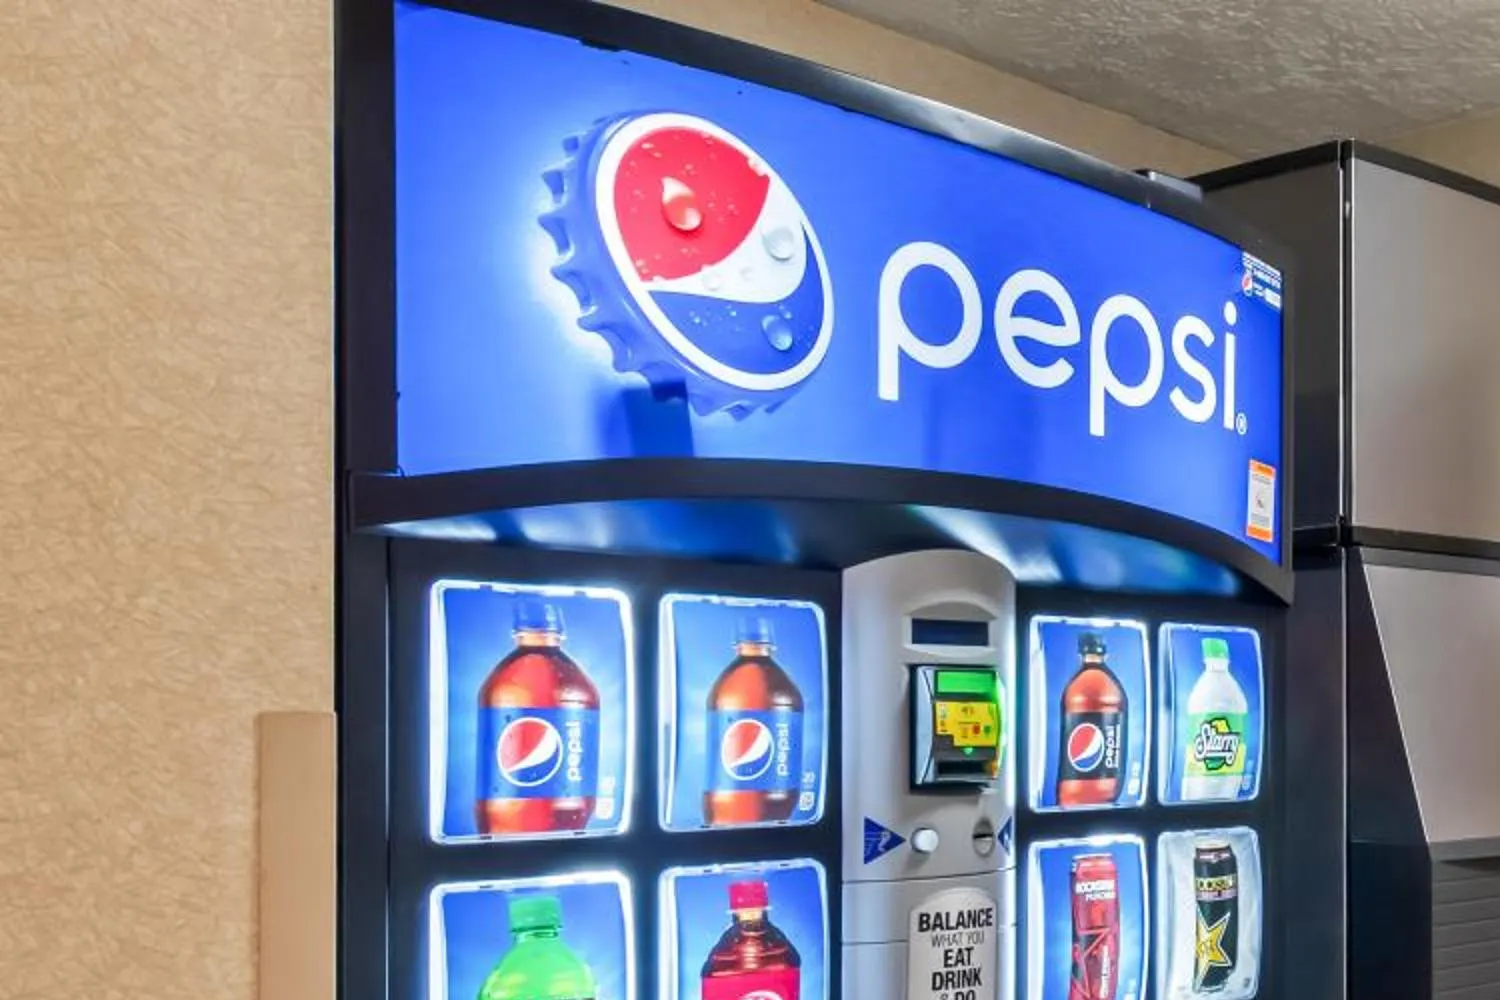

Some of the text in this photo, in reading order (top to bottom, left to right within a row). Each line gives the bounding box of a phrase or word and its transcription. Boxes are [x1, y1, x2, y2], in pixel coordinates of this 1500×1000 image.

[877, 241, 1238, 437] pepsi
[566, 721, 583, 782] pepsi
[777, 723, 789, 776] pepsi
[918, 908, 993, 932] BALANCE
[931, 930, 985, 949] WHAT YOU
[943, 947, 975, 969] EAT
[931, 967, 983, 992] DRINK
